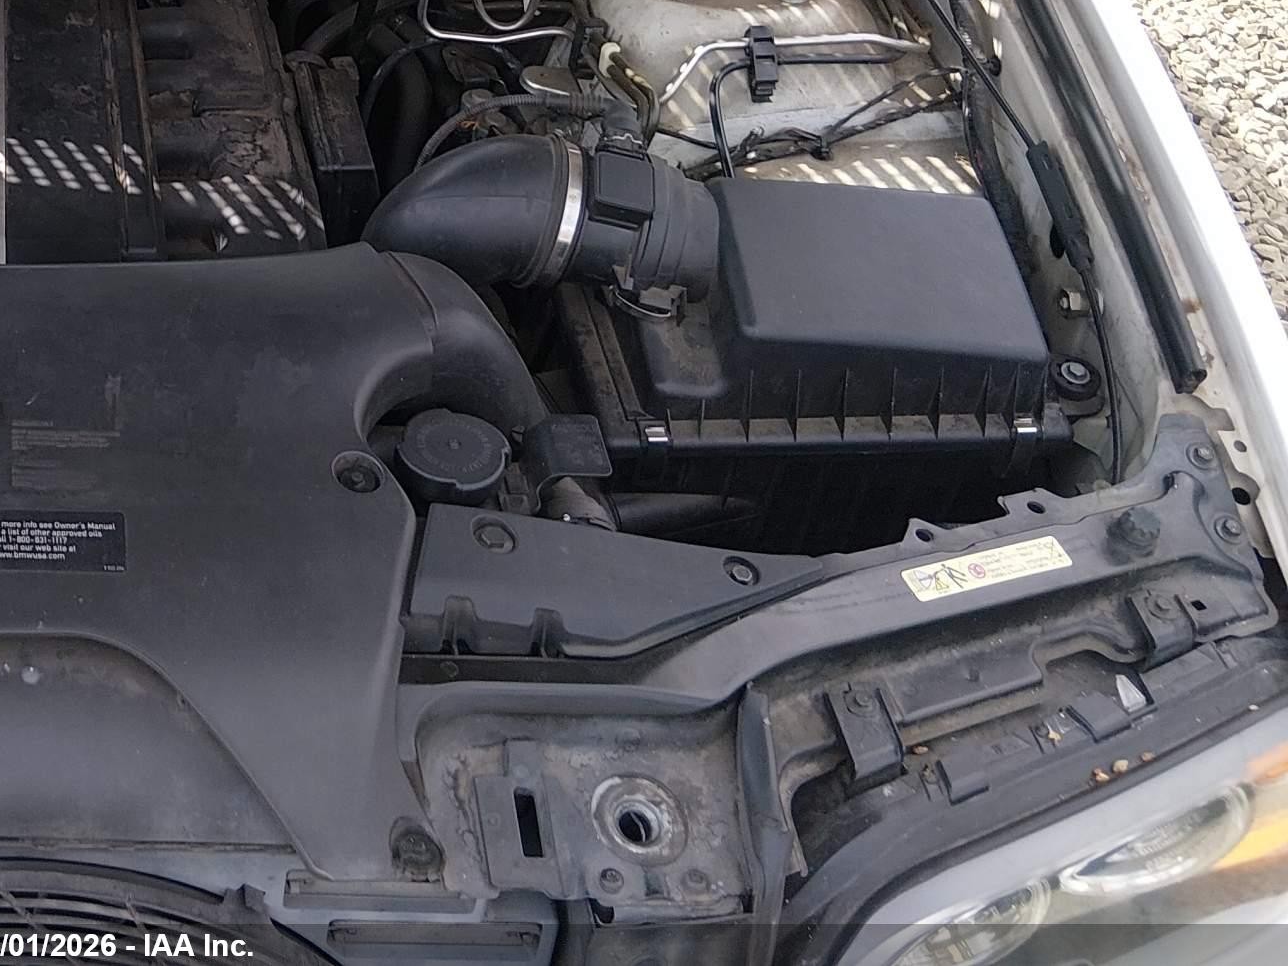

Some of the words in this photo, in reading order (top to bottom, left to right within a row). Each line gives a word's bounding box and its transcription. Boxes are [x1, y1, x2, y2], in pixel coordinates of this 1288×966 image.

[23, 520, 37, 528] info
[54, 521, 85, 529] Owner's
[87, 522, 115, 530] Manual
[7, 527, 20, 535] list
[52, 529, 87, 537] approved
[3, 543, 19, 551] visit
